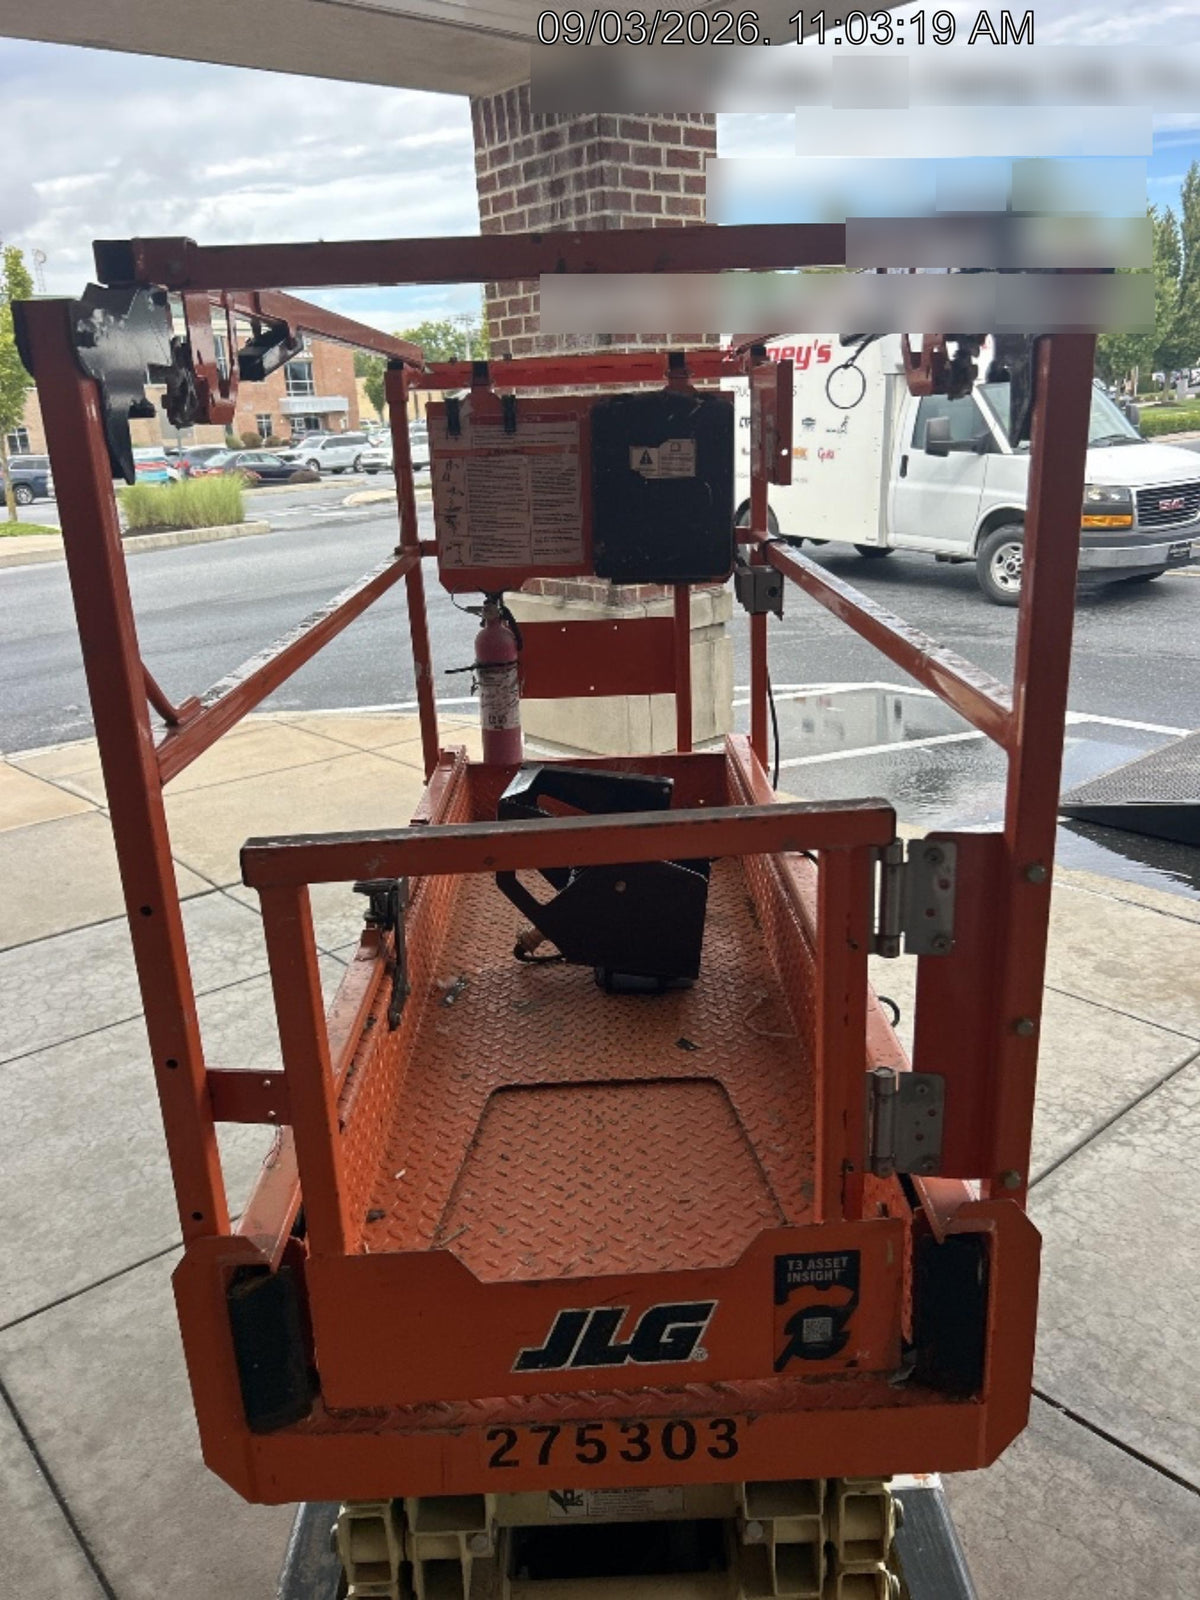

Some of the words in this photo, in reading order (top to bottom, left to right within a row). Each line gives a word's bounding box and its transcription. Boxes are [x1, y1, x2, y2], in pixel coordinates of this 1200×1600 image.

[787, 1260, 803, 1271] T3
[807, 1256, 849, 1270] ASSET
[787, 1269, 841, 1283] INSIGHT
[486, 1417, 739, 1469] 275303
